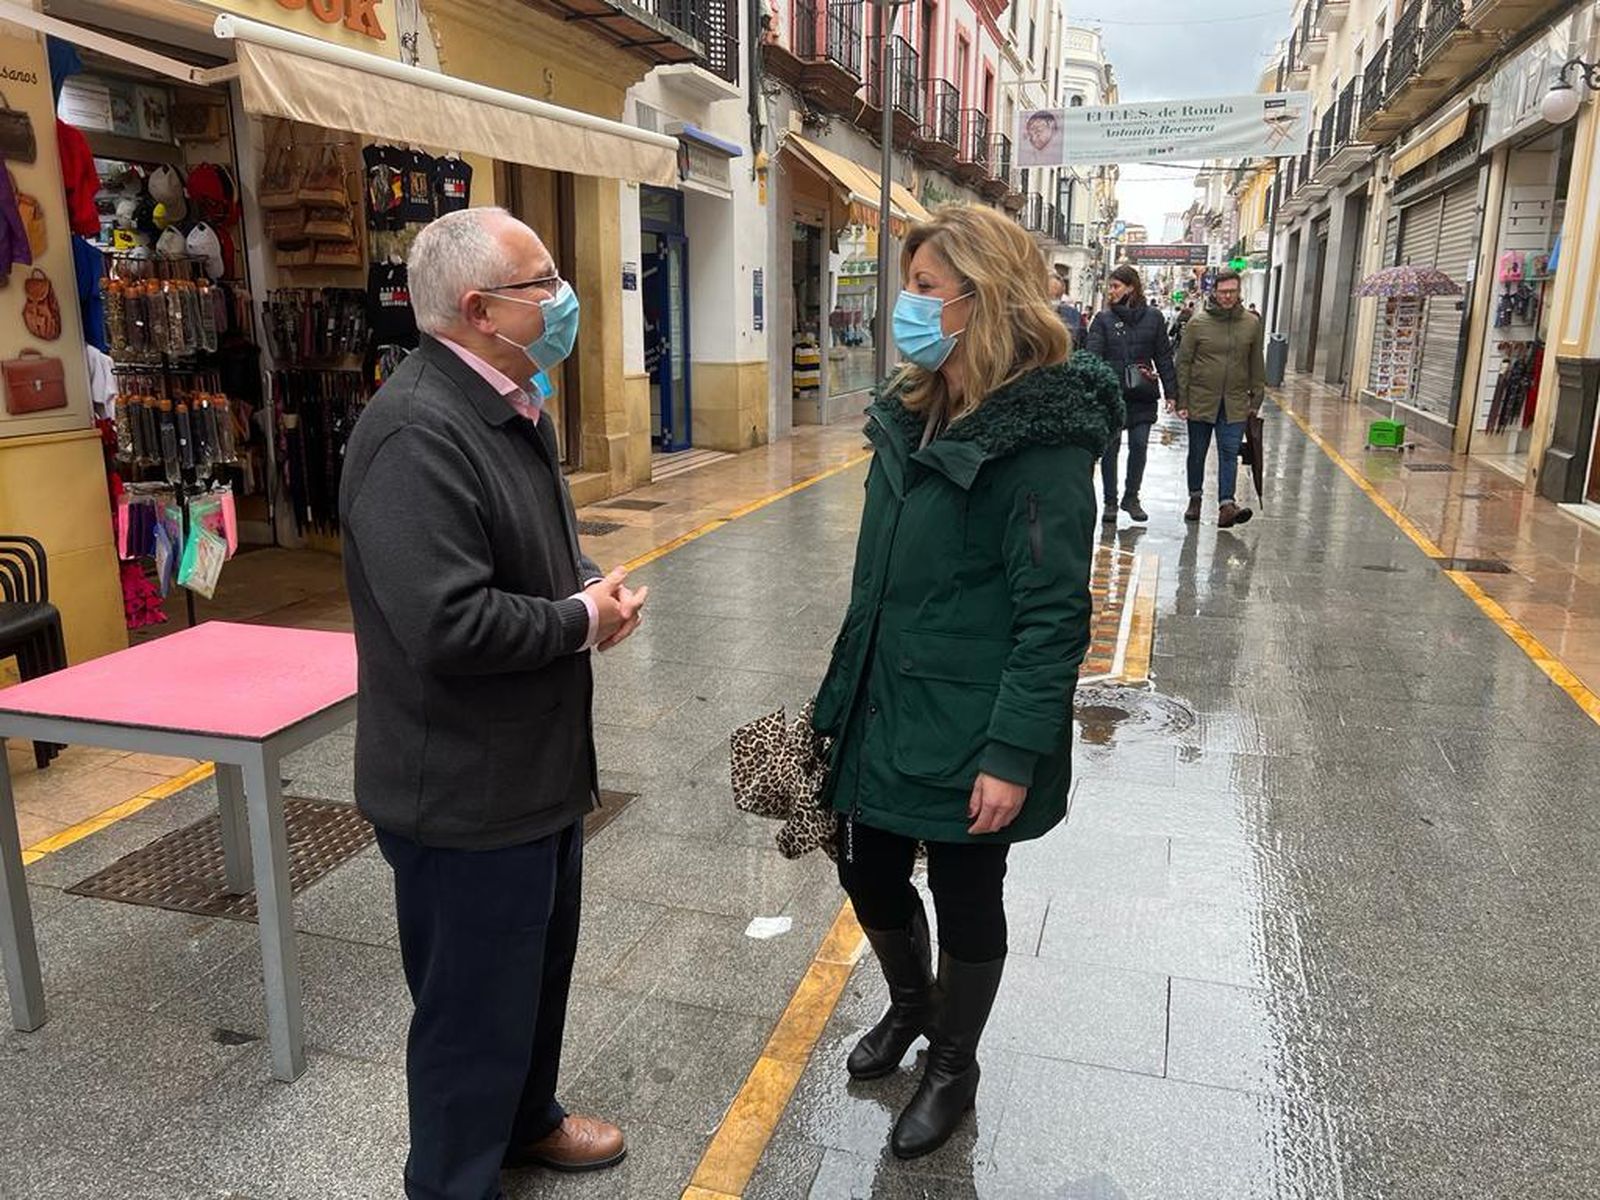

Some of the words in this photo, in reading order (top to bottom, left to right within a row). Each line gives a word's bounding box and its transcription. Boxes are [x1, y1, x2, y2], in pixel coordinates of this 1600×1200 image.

[1158, 107, 1177, 118] de
[1182, 103, 1234, 117] Ronda
[1102, 126, 1156, 138] Antonio
